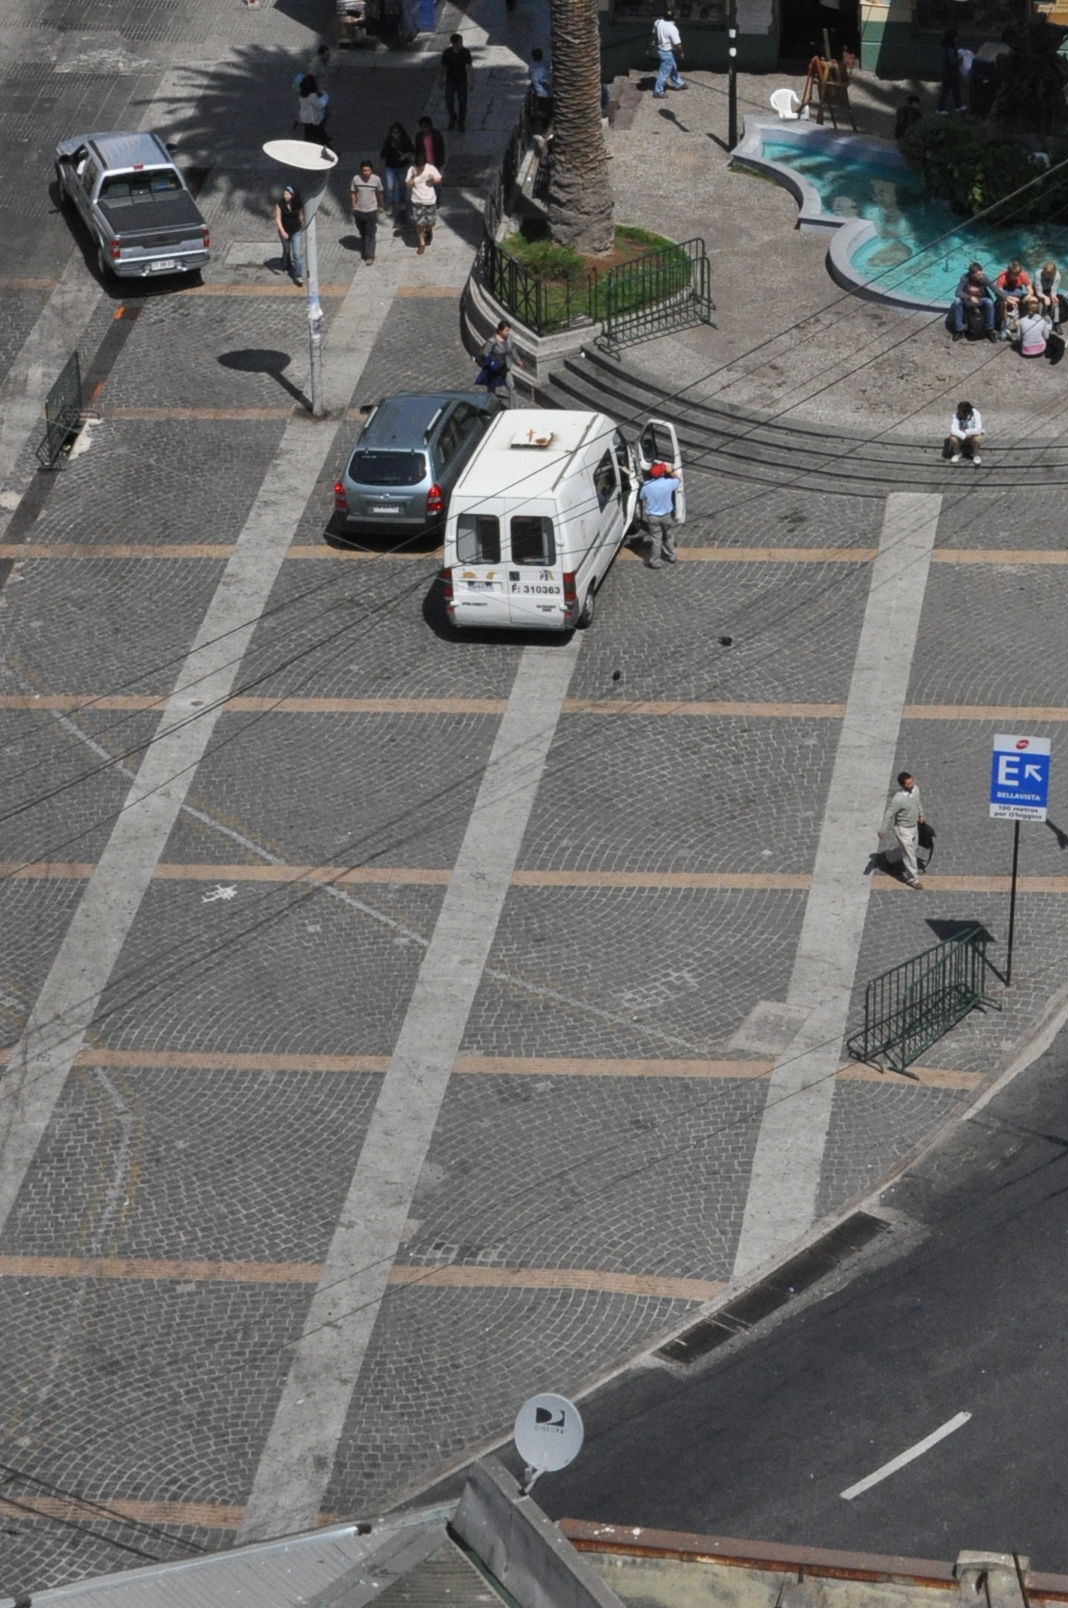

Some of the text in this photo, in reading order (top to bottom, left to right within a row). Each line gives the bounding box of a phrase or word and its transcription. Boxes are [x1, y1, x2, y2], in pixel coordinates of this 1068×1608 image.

[523, 585, 560, 594] 310363
[997, 755, 1020, 786] E
[997, 792, 1041, 801] BELLAVISTA
